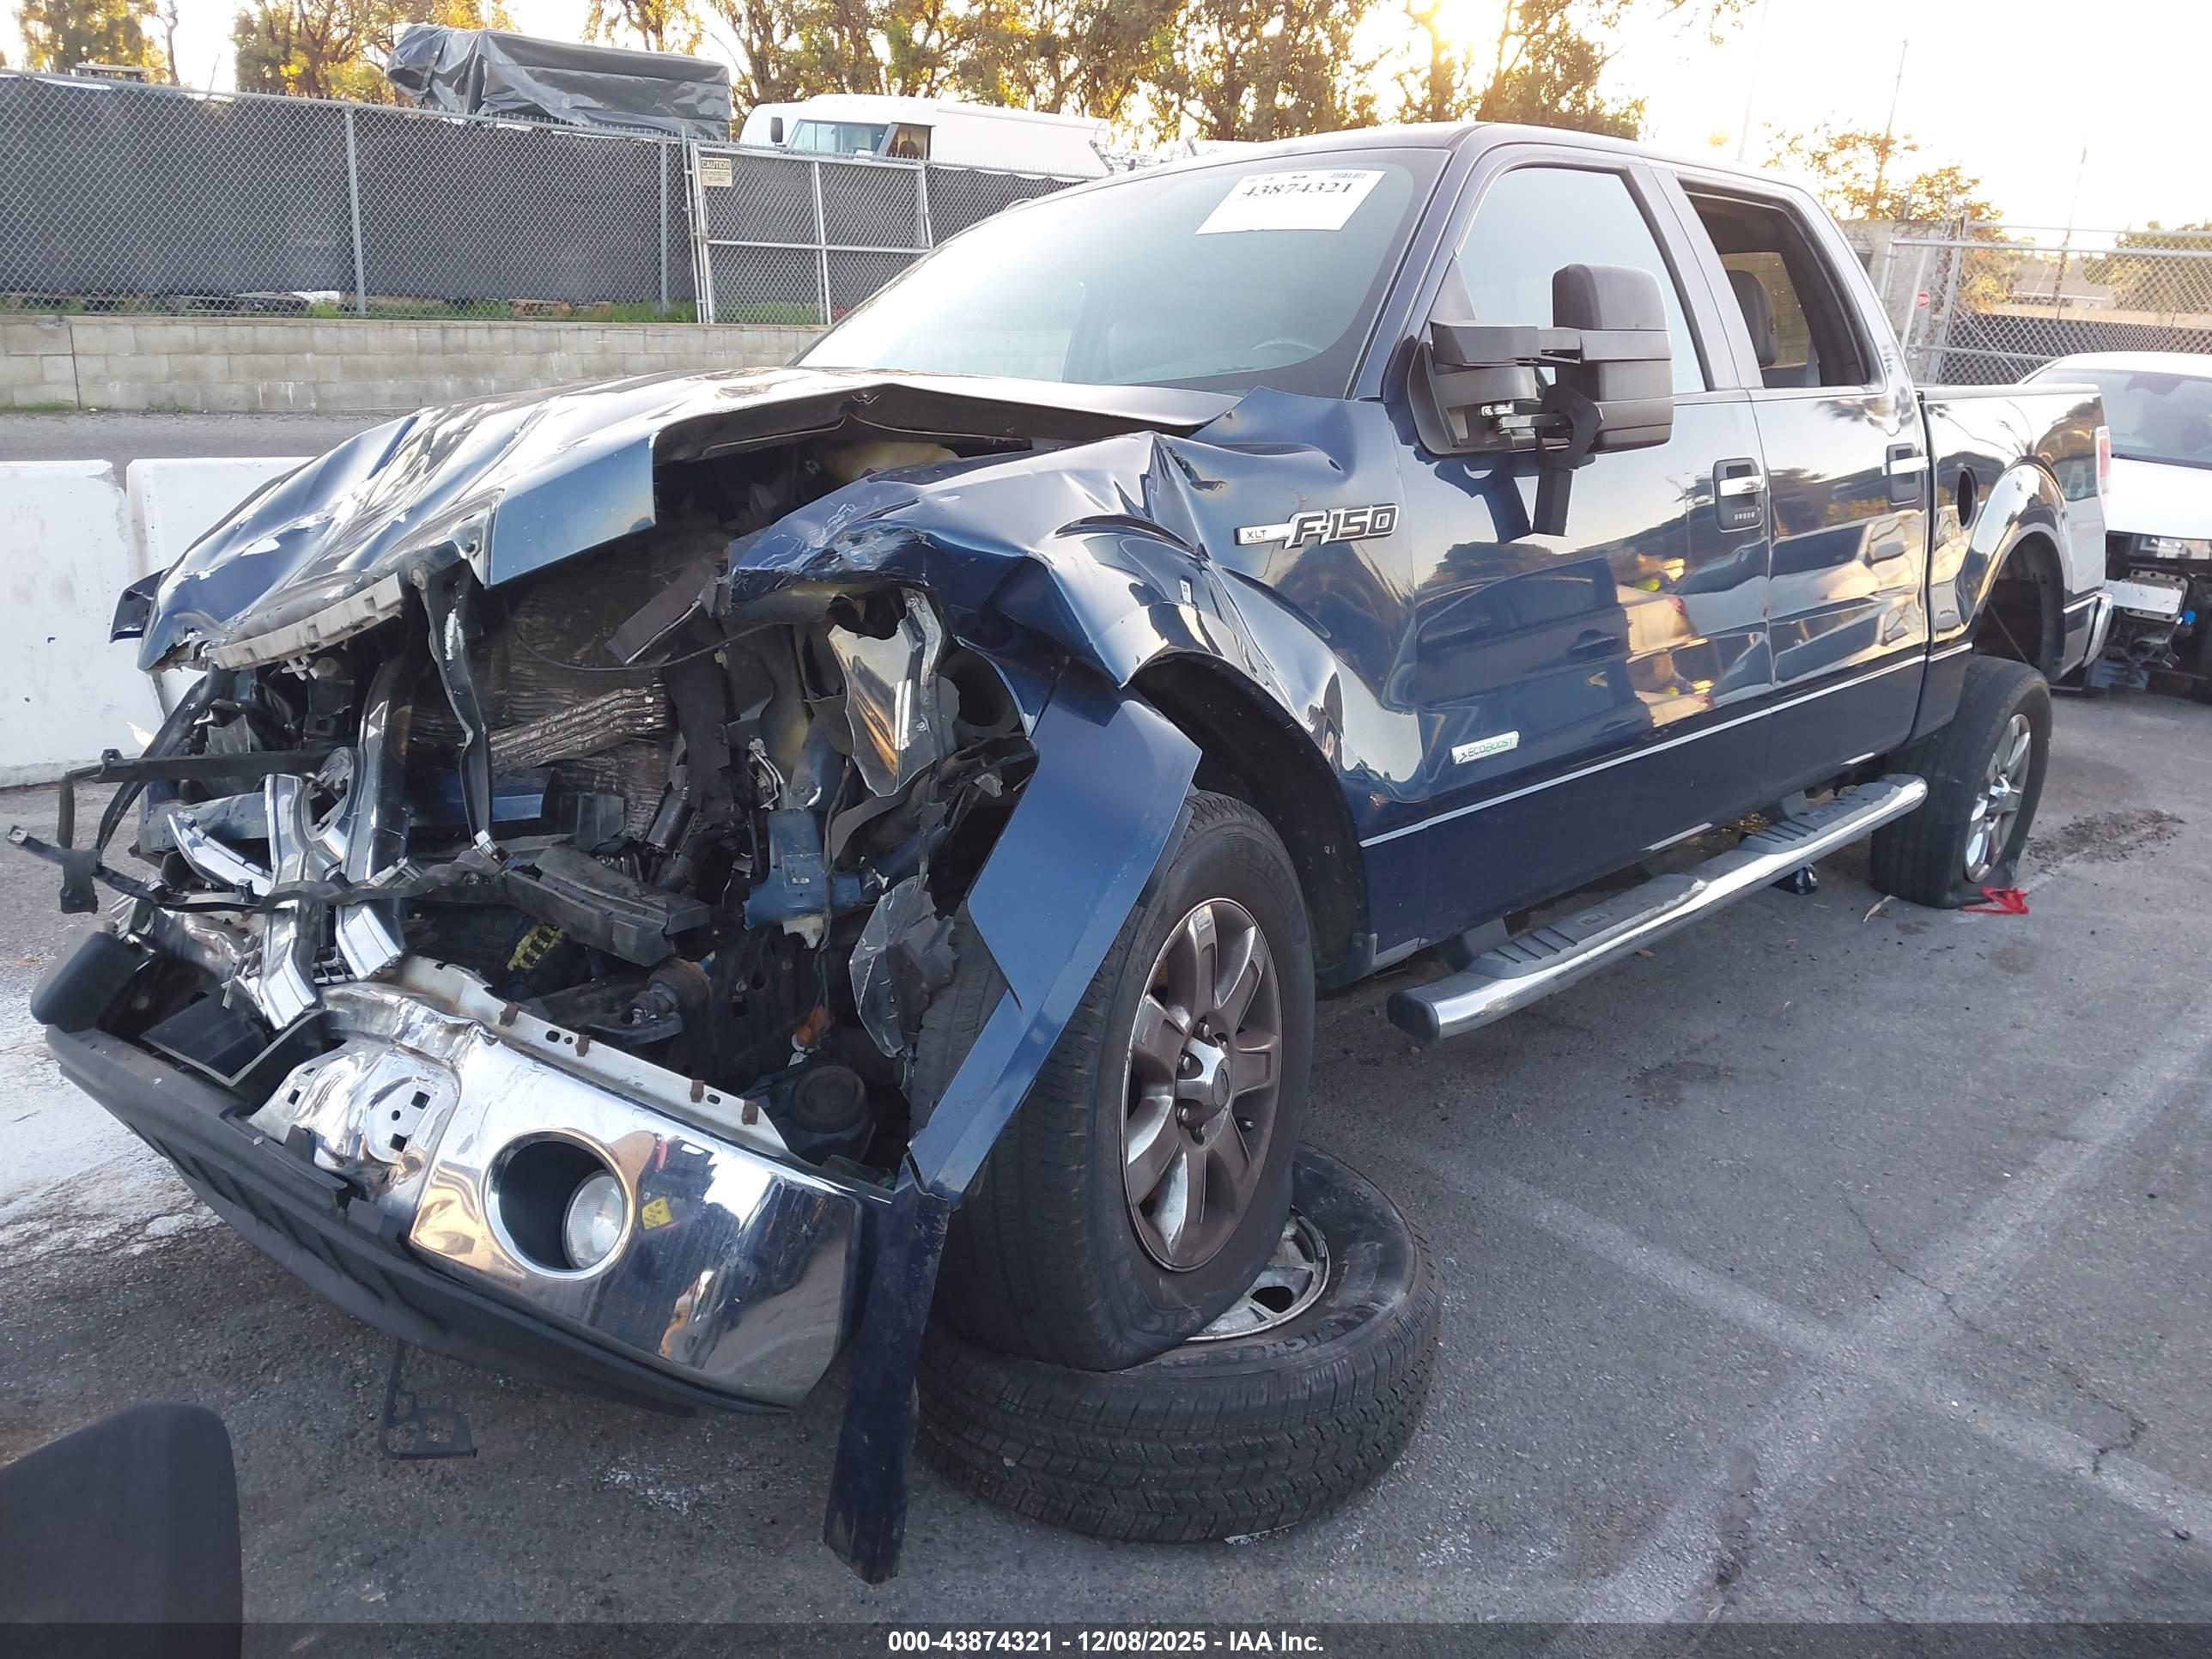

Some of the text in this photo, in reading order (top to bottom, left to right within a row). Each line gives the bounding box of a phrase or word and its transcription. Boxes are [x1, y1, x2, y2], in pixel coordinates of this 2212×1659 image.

[702, 161, 729, 169] CAUTION
[1243, 181, 1353, 197] 43874321
[1246, 529, 1267, 539] XLT
[1468, 737, 1514, 757] ECOBOOST
